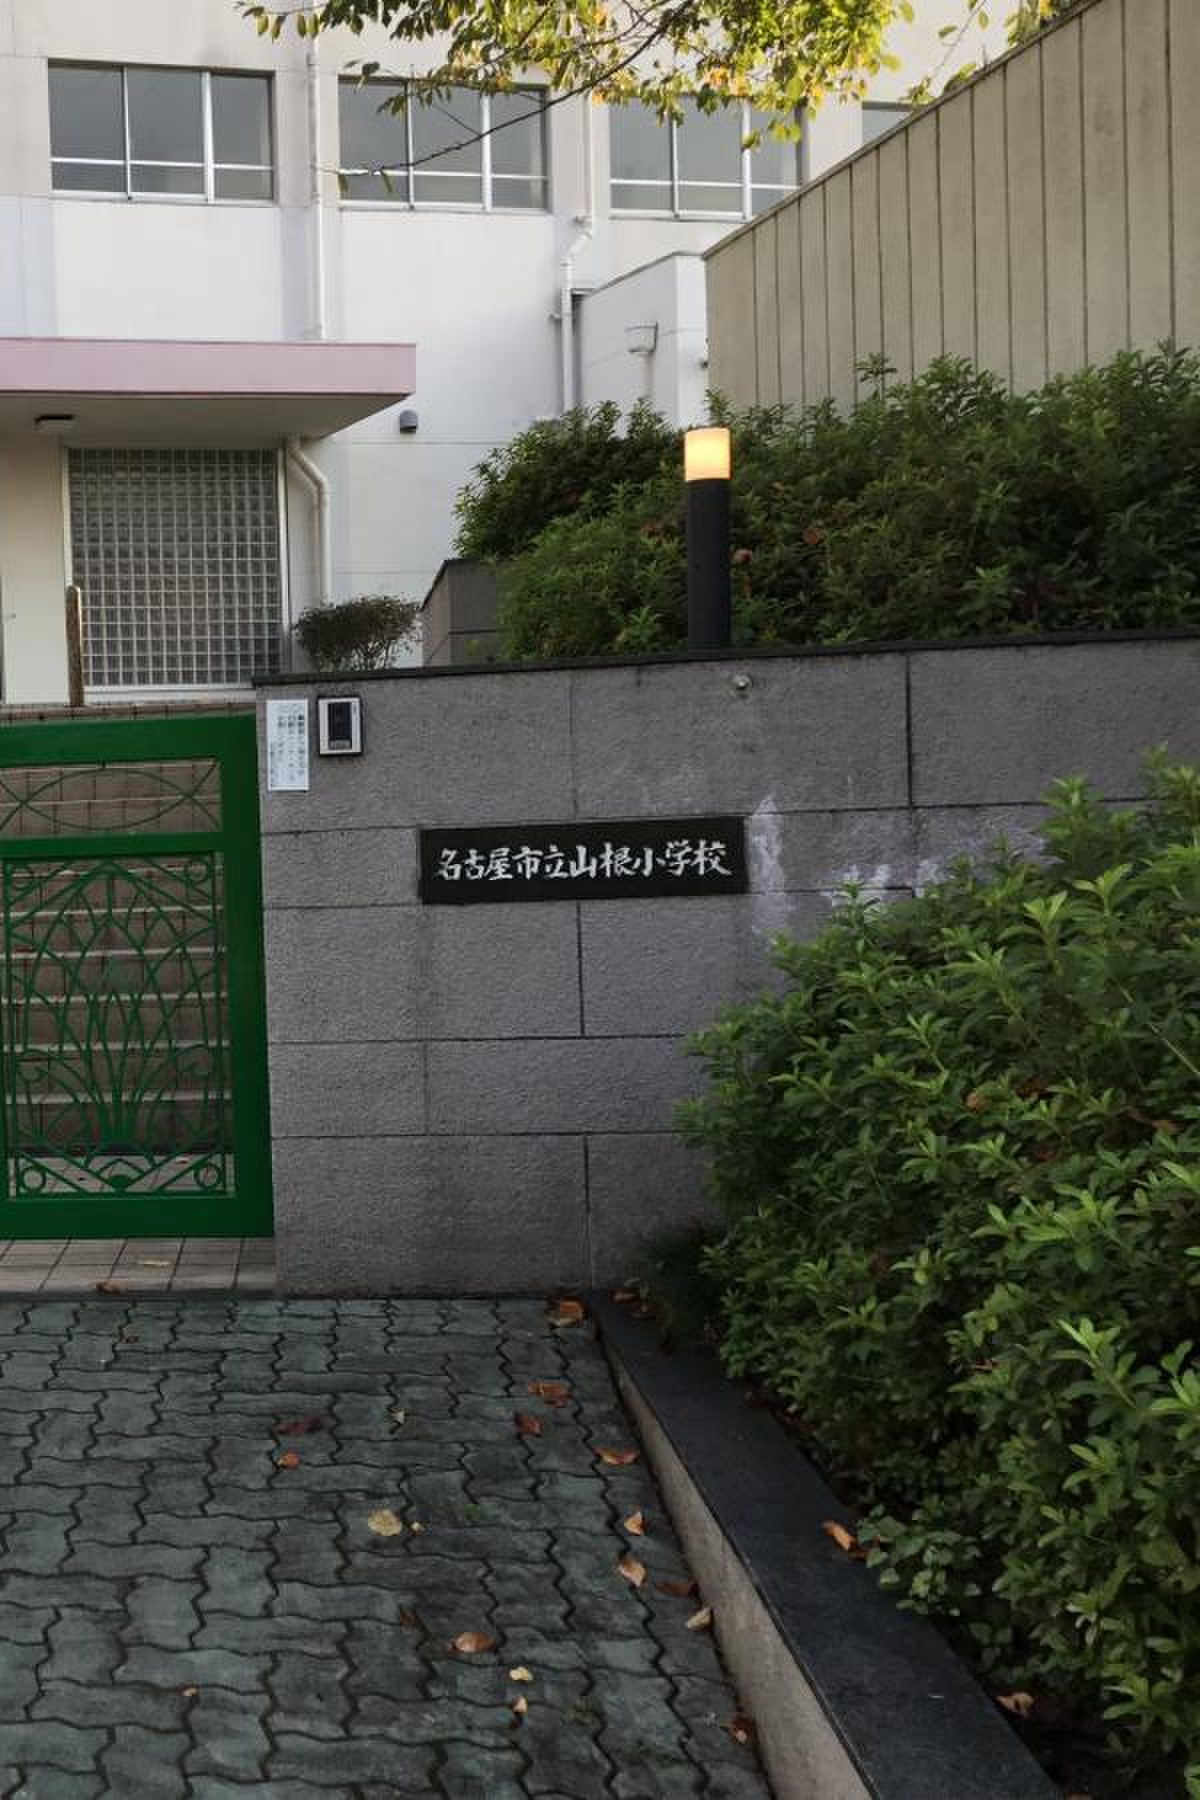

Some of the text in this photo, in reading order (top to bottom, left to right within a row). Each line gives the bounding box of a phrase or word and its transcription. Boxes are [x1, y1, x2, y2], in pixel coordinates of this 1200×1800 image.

[437, 839, 732, 881] 名古屋市立山根小学校
